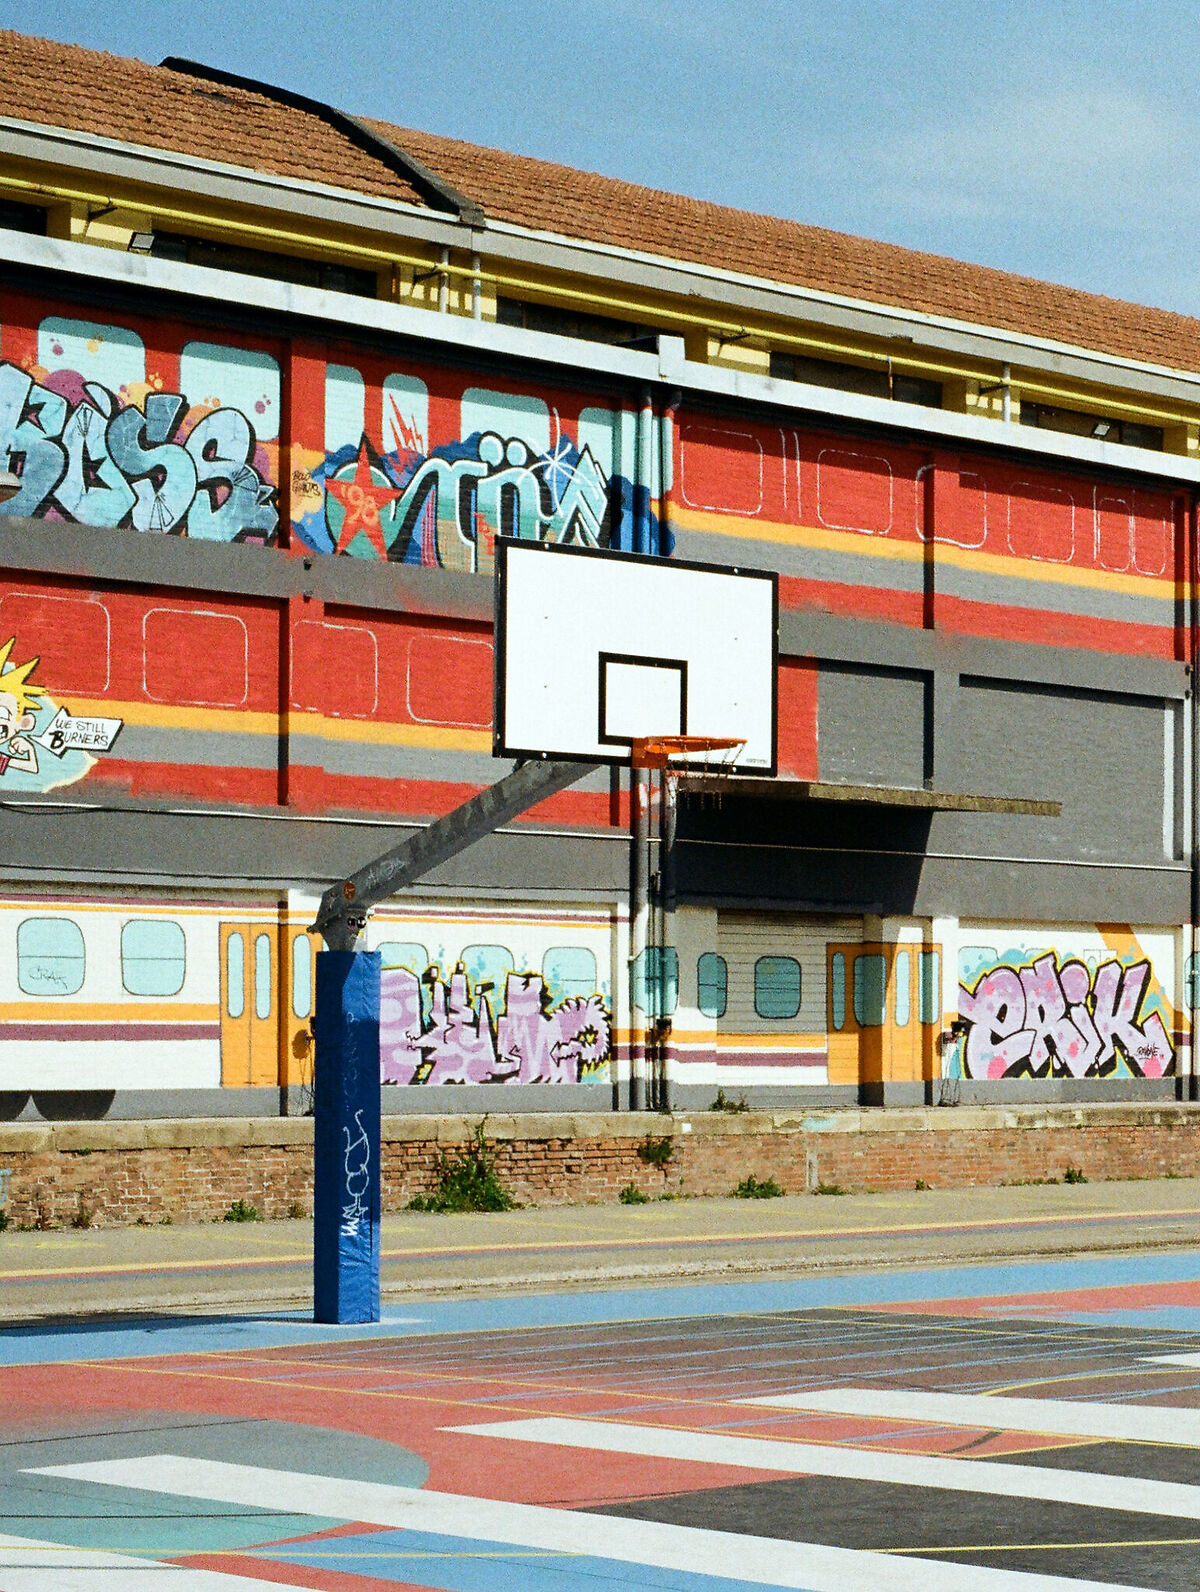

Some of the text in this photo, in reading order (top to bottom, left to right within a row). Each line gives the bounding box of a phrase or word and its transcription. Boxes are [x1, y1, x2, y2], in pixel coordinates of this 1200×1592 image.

[55, 718, 106, 733] WE STILL
[48, 730, 109, 749] BURNERS
